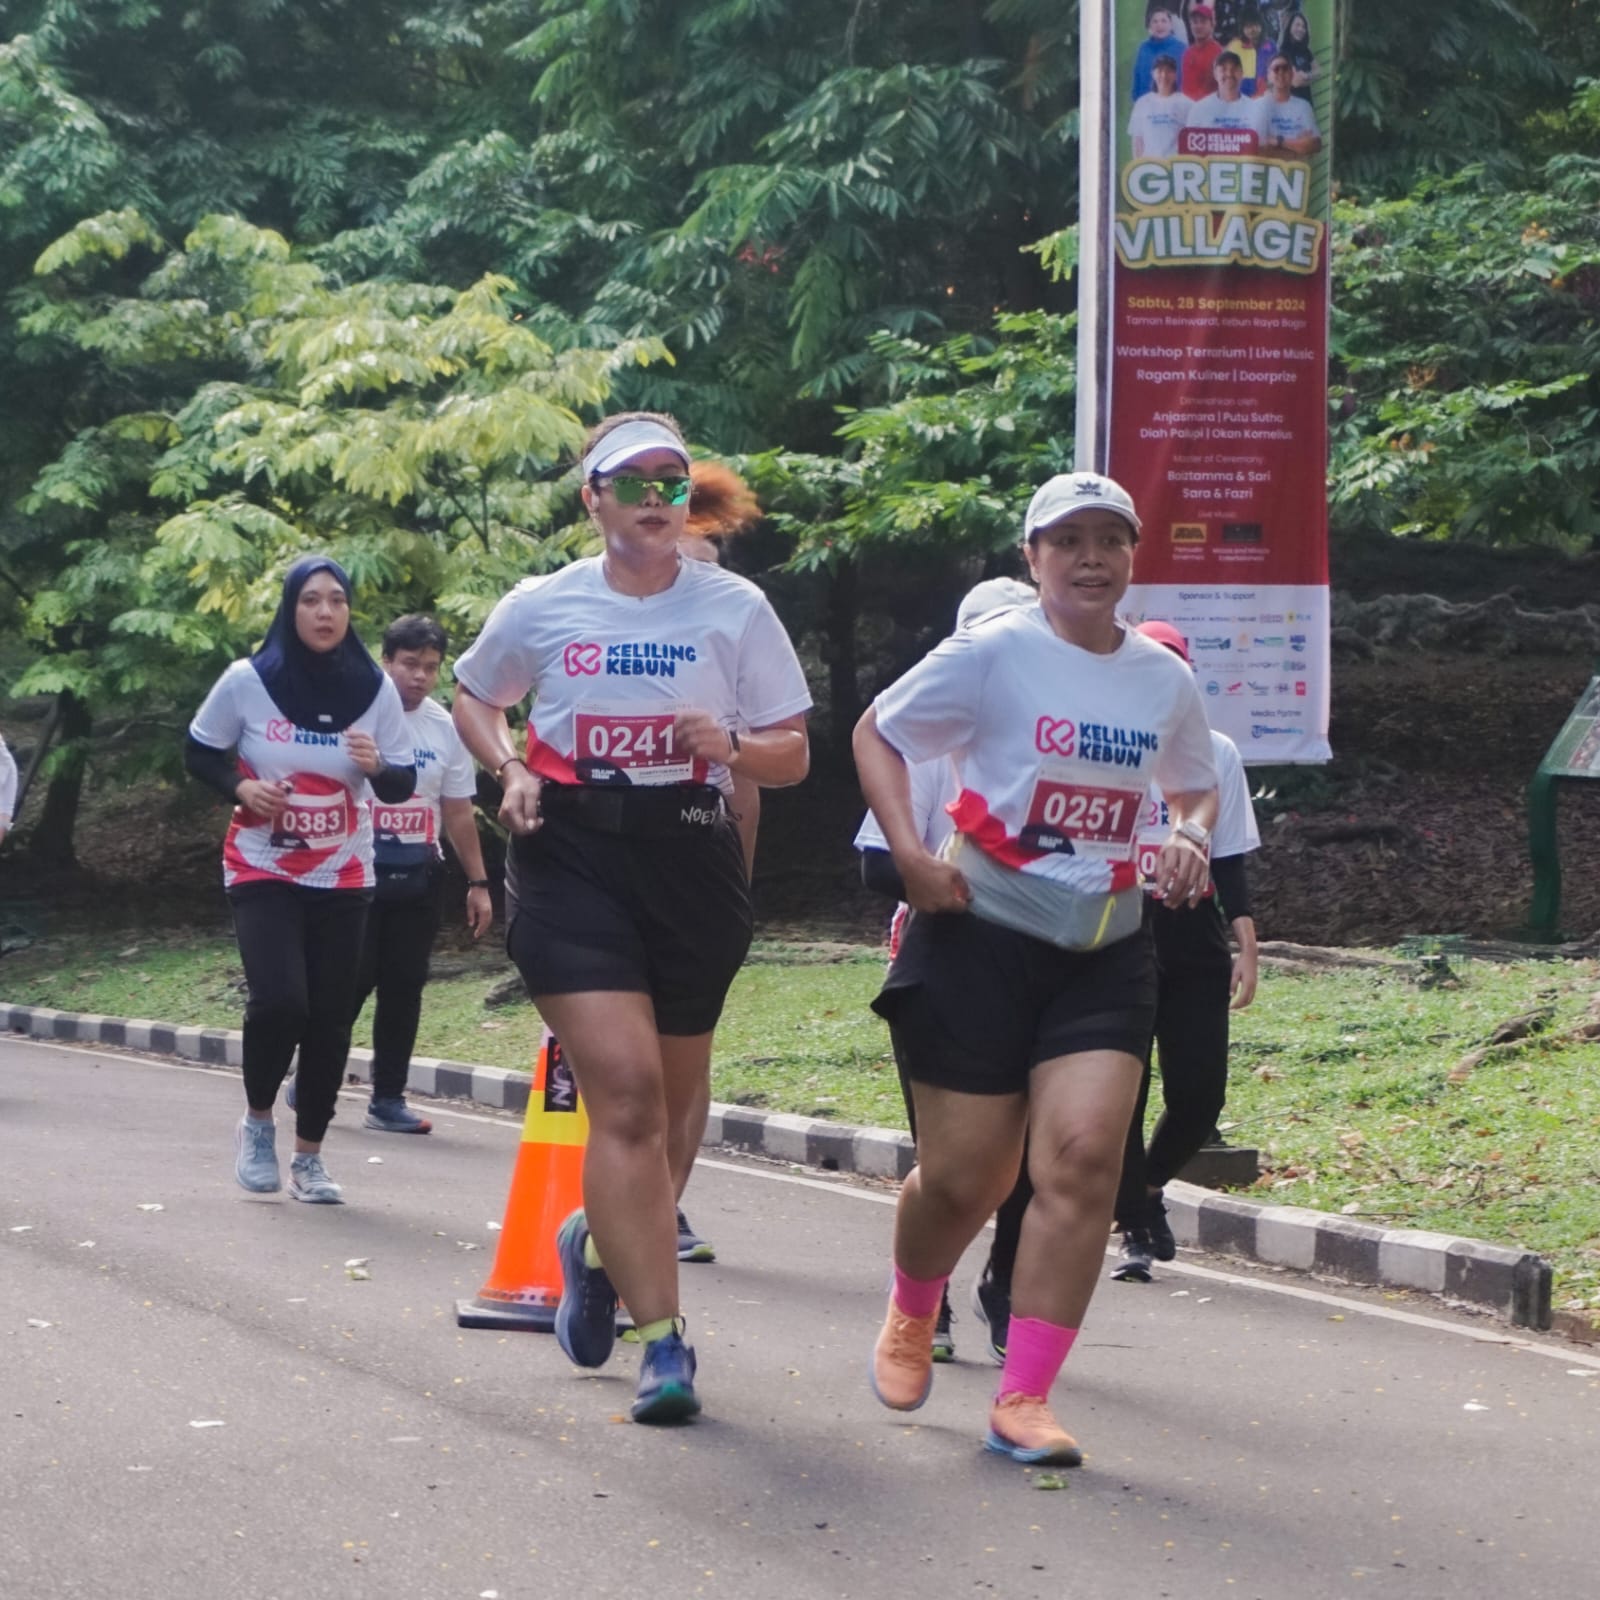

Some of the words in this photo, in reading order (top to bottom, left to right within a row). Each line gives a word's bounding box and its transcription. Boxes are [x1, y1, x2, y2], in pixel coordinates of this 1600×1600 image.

[1208, 133, 1251, 144] KELILING
[1208, 142, 1240, 152] KEBUN
[1128, 161, 1305, 208] GREEN
[1115, 215, 1316, 266] VILLAGE
[1127, 296, 1174, 310] Sabtu,
[1178, 296, 1194, 309] 28
[1198, 297, 1273, 312] September
[1276, 298, 1306, 312] 2024
[1116, 345, 1183, 360] Workshop
[1256, 346, 1281, 359] Live
[1283, 347, 1315, 360] Music
[1136, 369, 1185, 384] Ragam
[1240, 370, 1297, 384] Doorprize
[1223, 411, 1249, 422] Putu
[1248, 470, 1271, 481] Sari
[1182, 487, 1211, 499] Sara
[1225, 487, 1253, 499] Fazri
[1178, 591, 1213, 601] Sponsor
[607, 643, 696, 662] KELILING
[606, 658, 676, 678] KEBUN
[294, 732, 339, 747] KEBUN
[589, 724, 674, 757] 0241
[1079, 721, 1158, 752] KELILING
[1078, 741, 1141, 768] KEBUN
[380, 811, 423, 829] 0377
[1043, 791, 1124, 832] 0251
[282, 810, 340, 832] 0383
